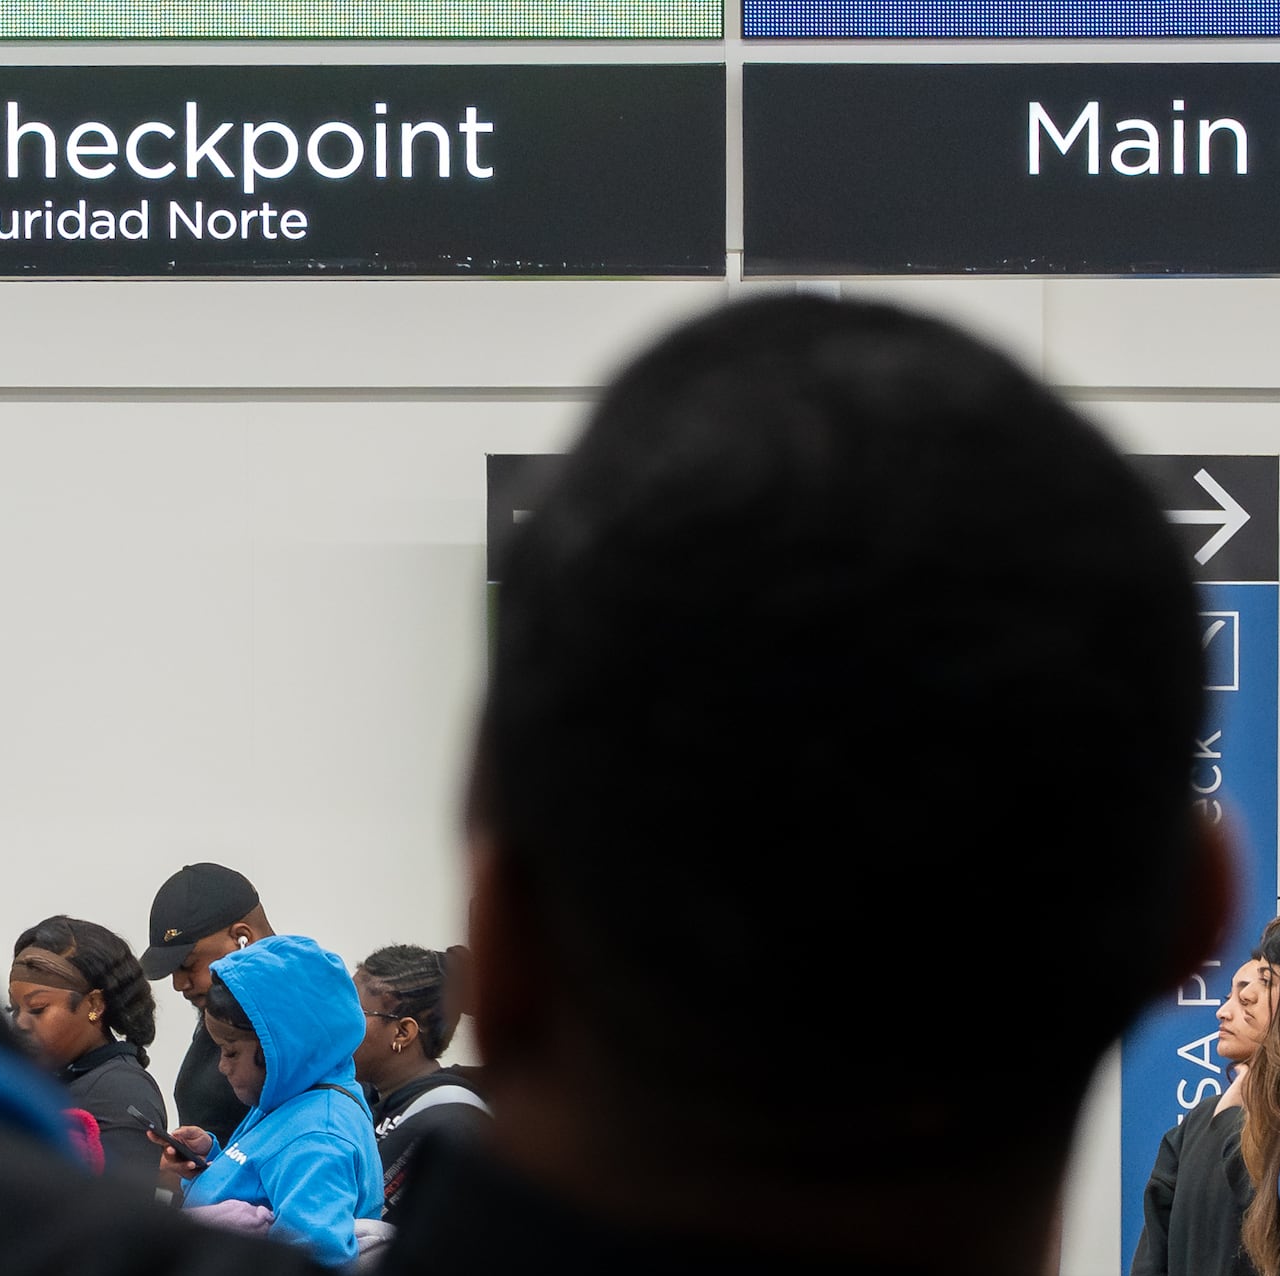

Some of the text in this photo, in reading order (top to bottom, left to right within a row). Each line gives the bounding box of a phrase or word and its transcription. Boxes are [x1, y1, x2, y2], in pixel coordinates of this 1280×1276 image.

[1029, 99, 1248, 176] Main
[169, 200, 308, 240] Norte
[1177, 1031, 1222, 1126] SA
